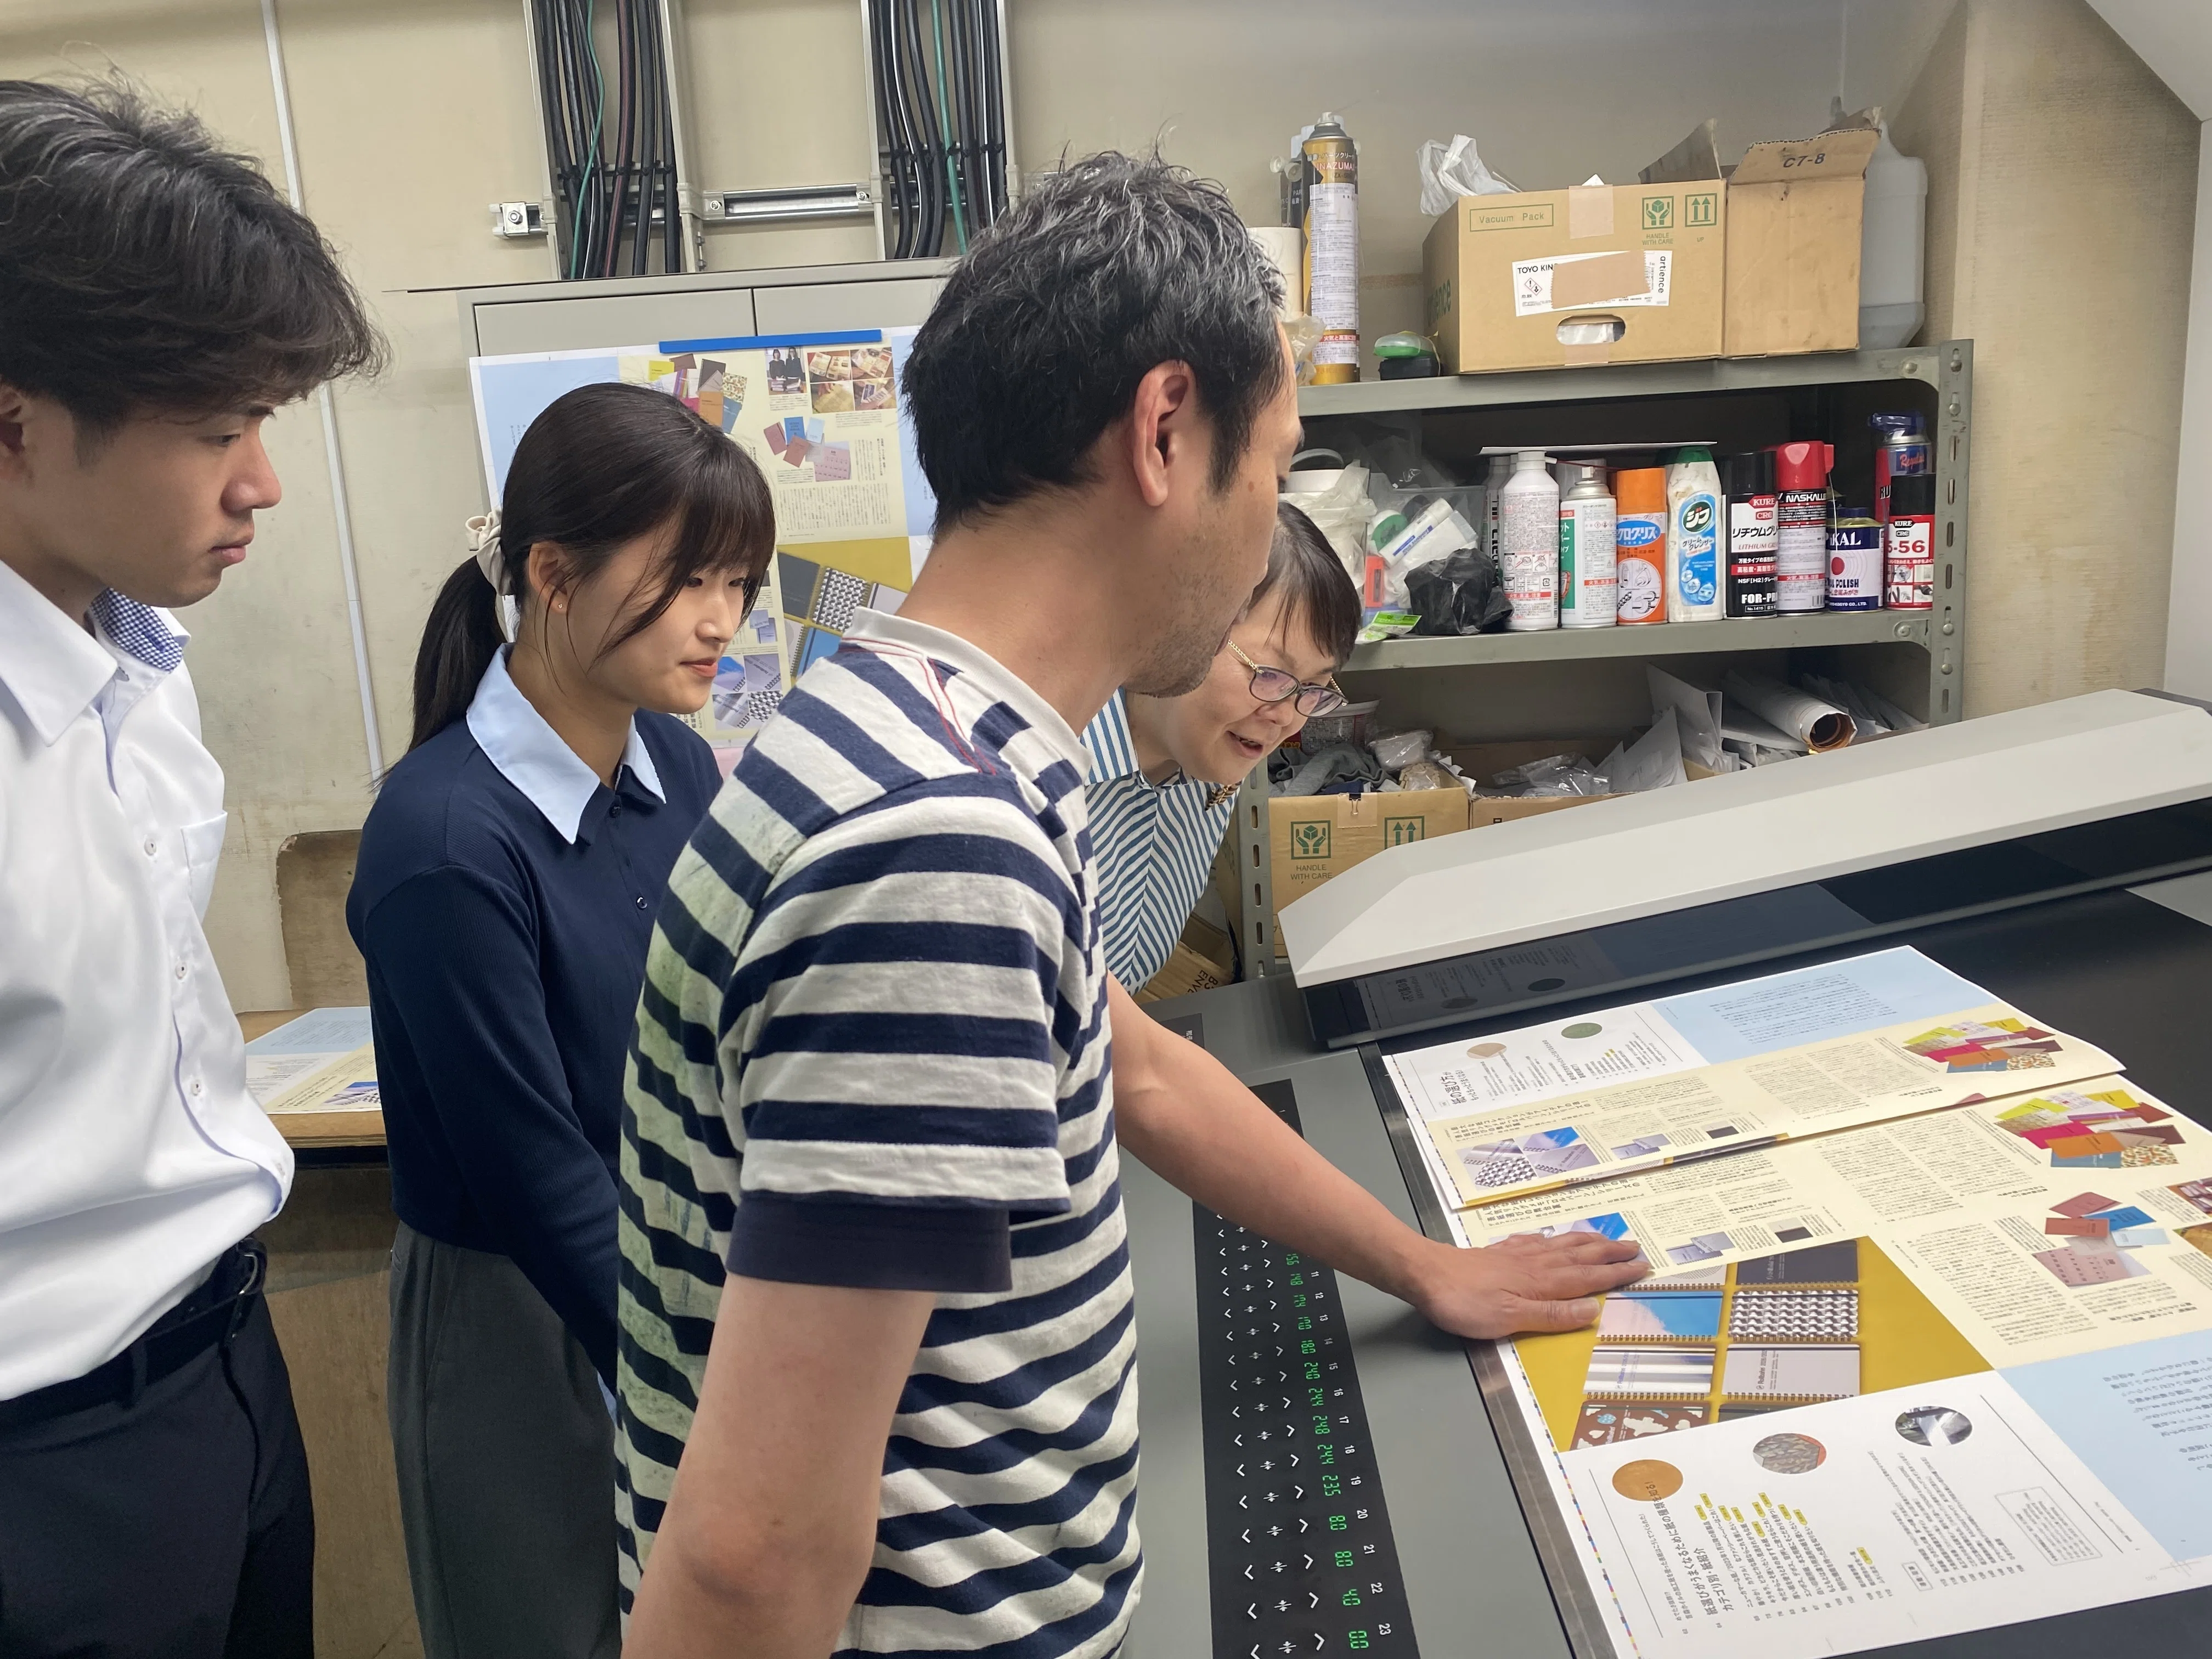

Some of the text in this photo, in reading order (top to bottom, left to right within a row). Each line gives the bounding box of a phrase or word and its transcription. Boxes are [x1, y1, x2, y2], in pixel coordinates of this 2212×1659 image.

[1479, 211, 1545, 224] Vacuum Pack
[1517, 266, 1538, 274] TOYO
[1658, 256, 1666, 294] artience
[1899, 454, 1925, 470] Regular
[1753, 498, 1775, 506] KURE
[1685, 506, 1710, 528] ジフ
[1887, 540, 1925, 554] 5-56
[1836, 579, 1859, 588] POLISH
[1438, 1070, 1468, 1104] 紙の選び方が
[1334, 1389, 1344, 1397] 16
[1339, 1416, 1349, 1424] 17
[1345, 1445, 1355, 1454] 18
[1350, 1476, 1361, 1486] 19
[1357, 1509, 1368, 1519] 20
[1363, 1544, 1375, 1554] 21
[1644, 1480, 1721, 1616] 紙選びがうまくなるために紙の種類を知る!
[1690, 1547, 1737, 1612] カテゴリ別・紙紹介
[1370, 1583, 1383, 1594] 22
[1378, 1623, 1391, 1635] 23
